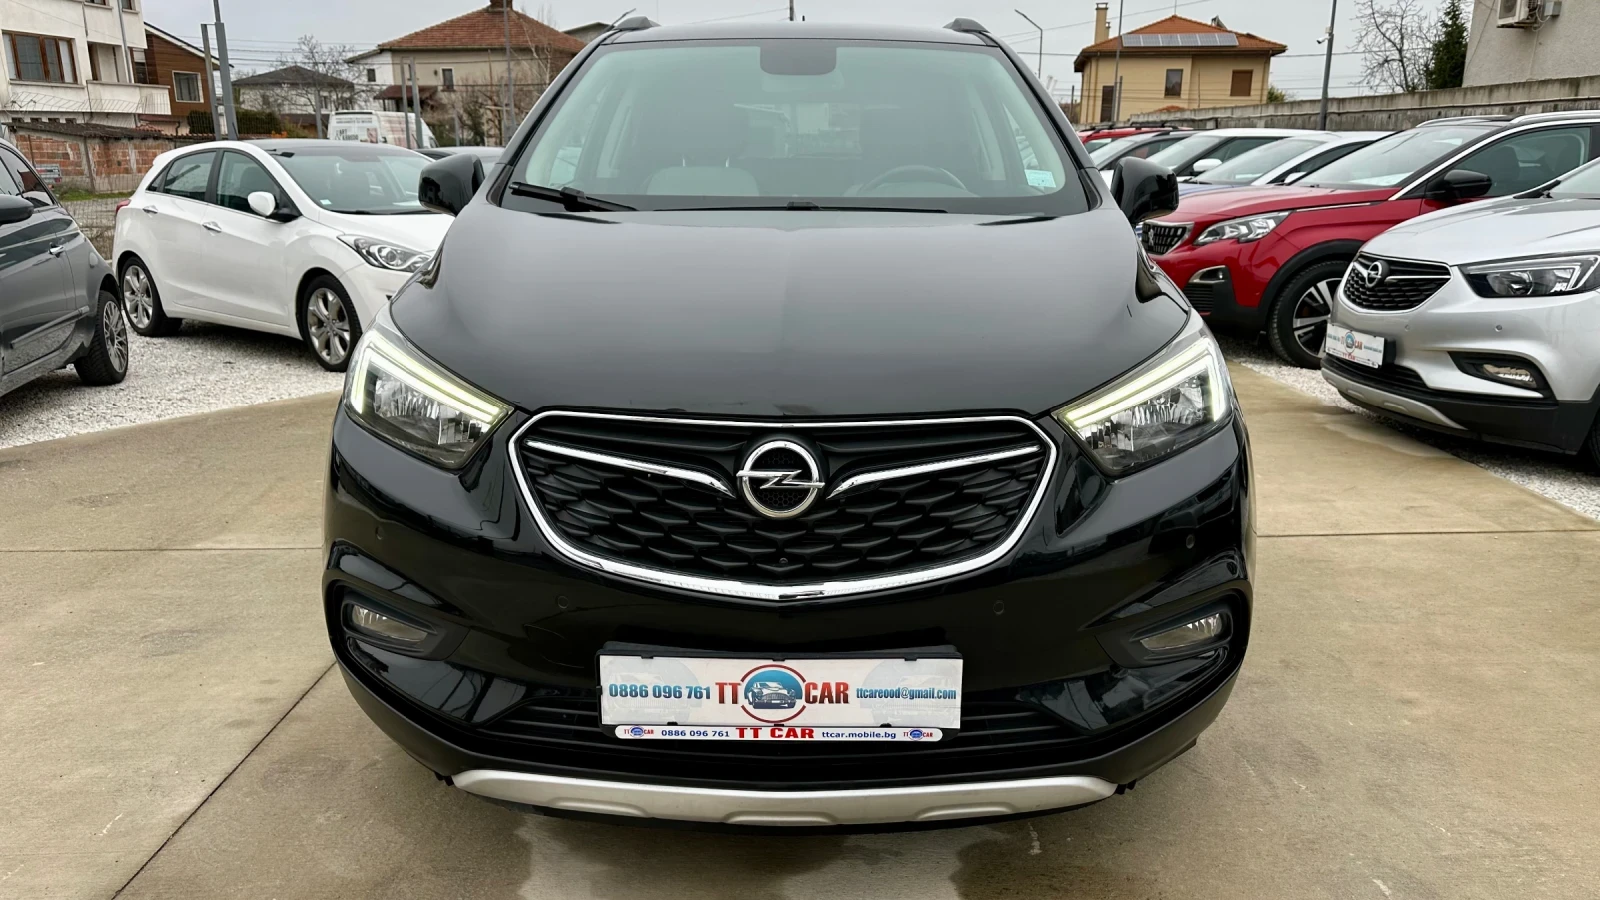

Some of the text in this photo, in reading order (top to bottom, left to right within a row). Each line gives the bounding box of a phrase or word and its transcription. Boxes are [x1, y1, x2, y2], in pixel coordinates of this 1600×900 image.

[608, 683, 711, 700] 0886 096 761
[715, 681, 850, 705] TT CAR
[855, 686, 957, 700] ttcareood@gmail.com
[661, 729, 730, 738] 0886 096 761
[735, 727, 815, 740] TT CAR
[821, 730, 897, 740] ttcar.mobile.bg
